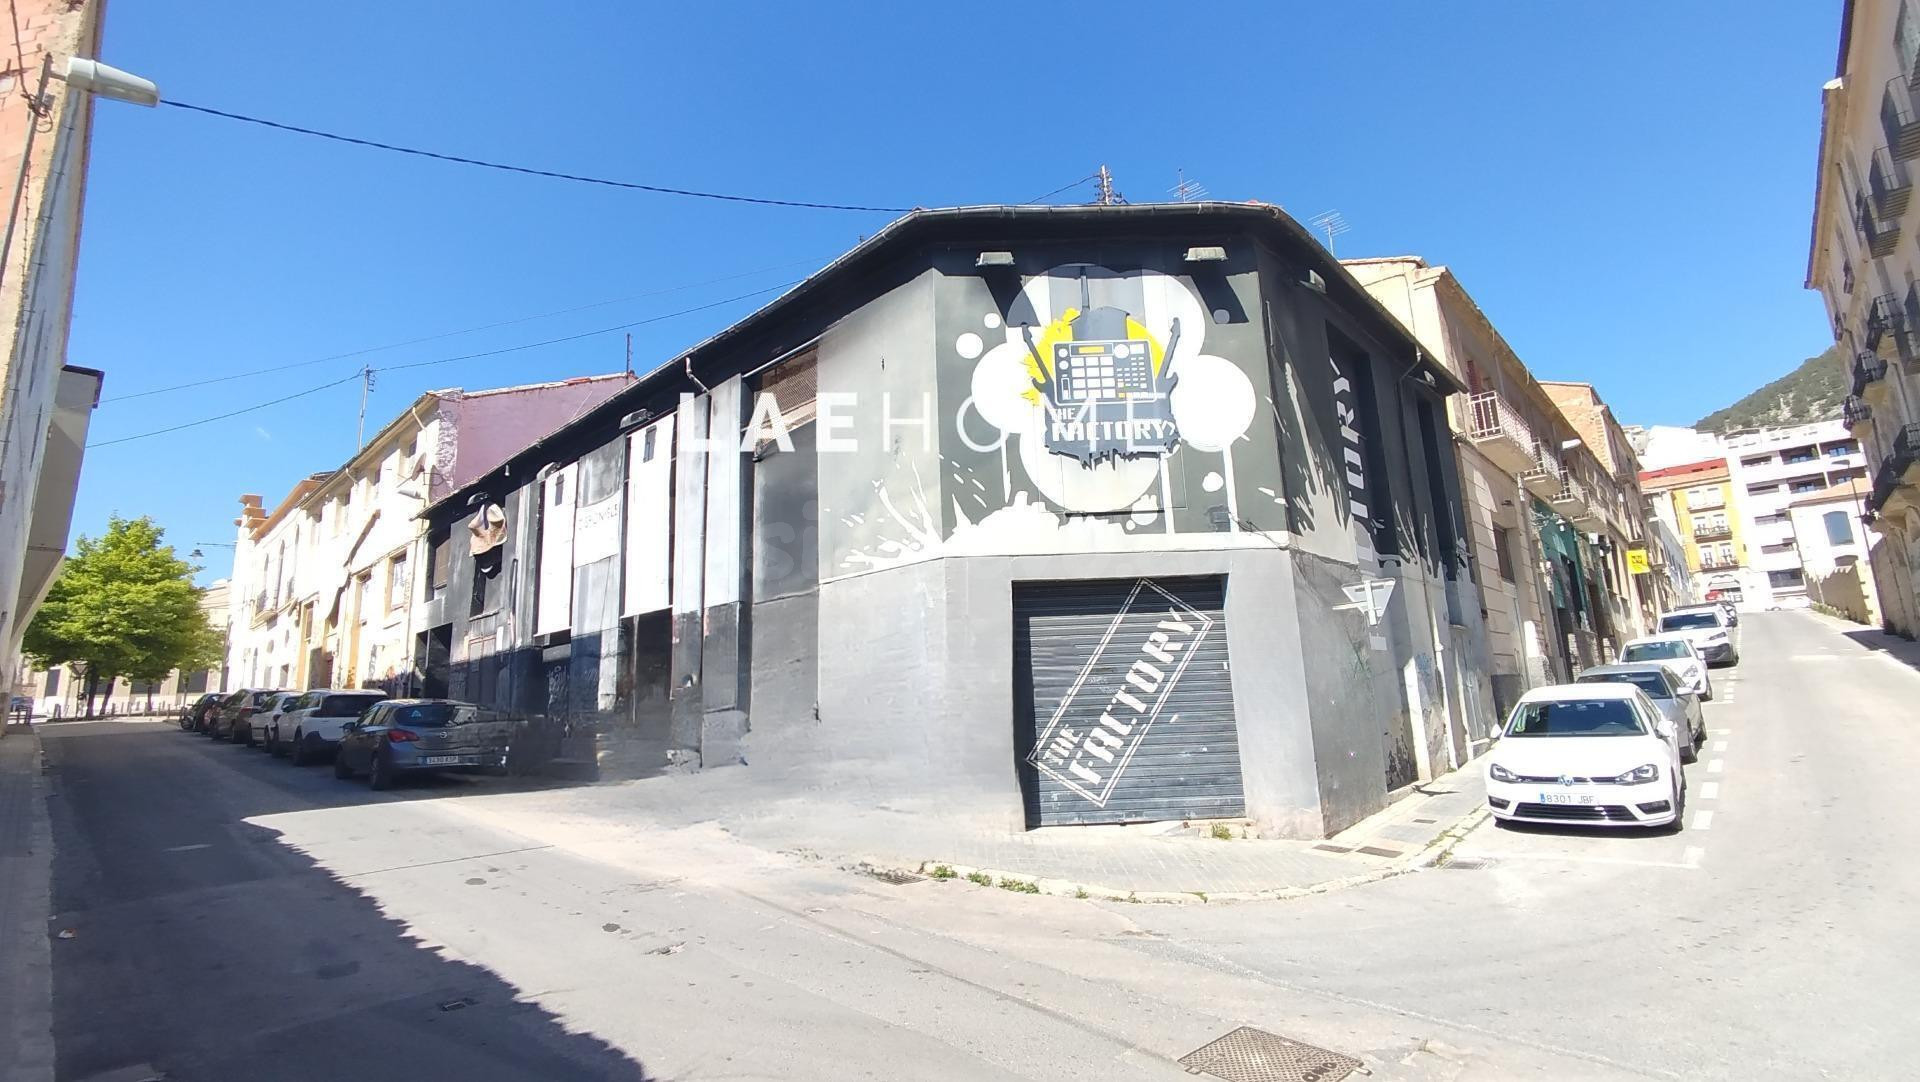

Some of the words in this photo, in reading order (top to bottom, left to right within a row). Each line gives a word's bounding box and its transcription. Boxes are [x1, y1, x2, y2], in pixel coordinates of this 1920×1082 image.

[1051, 418, 1168, 442] FACTORY
[1069, 606, 1194, 786] FACTORY
[1042, 724, 1083, 766] THE
[1546, 794, 1571, 804] 8301
